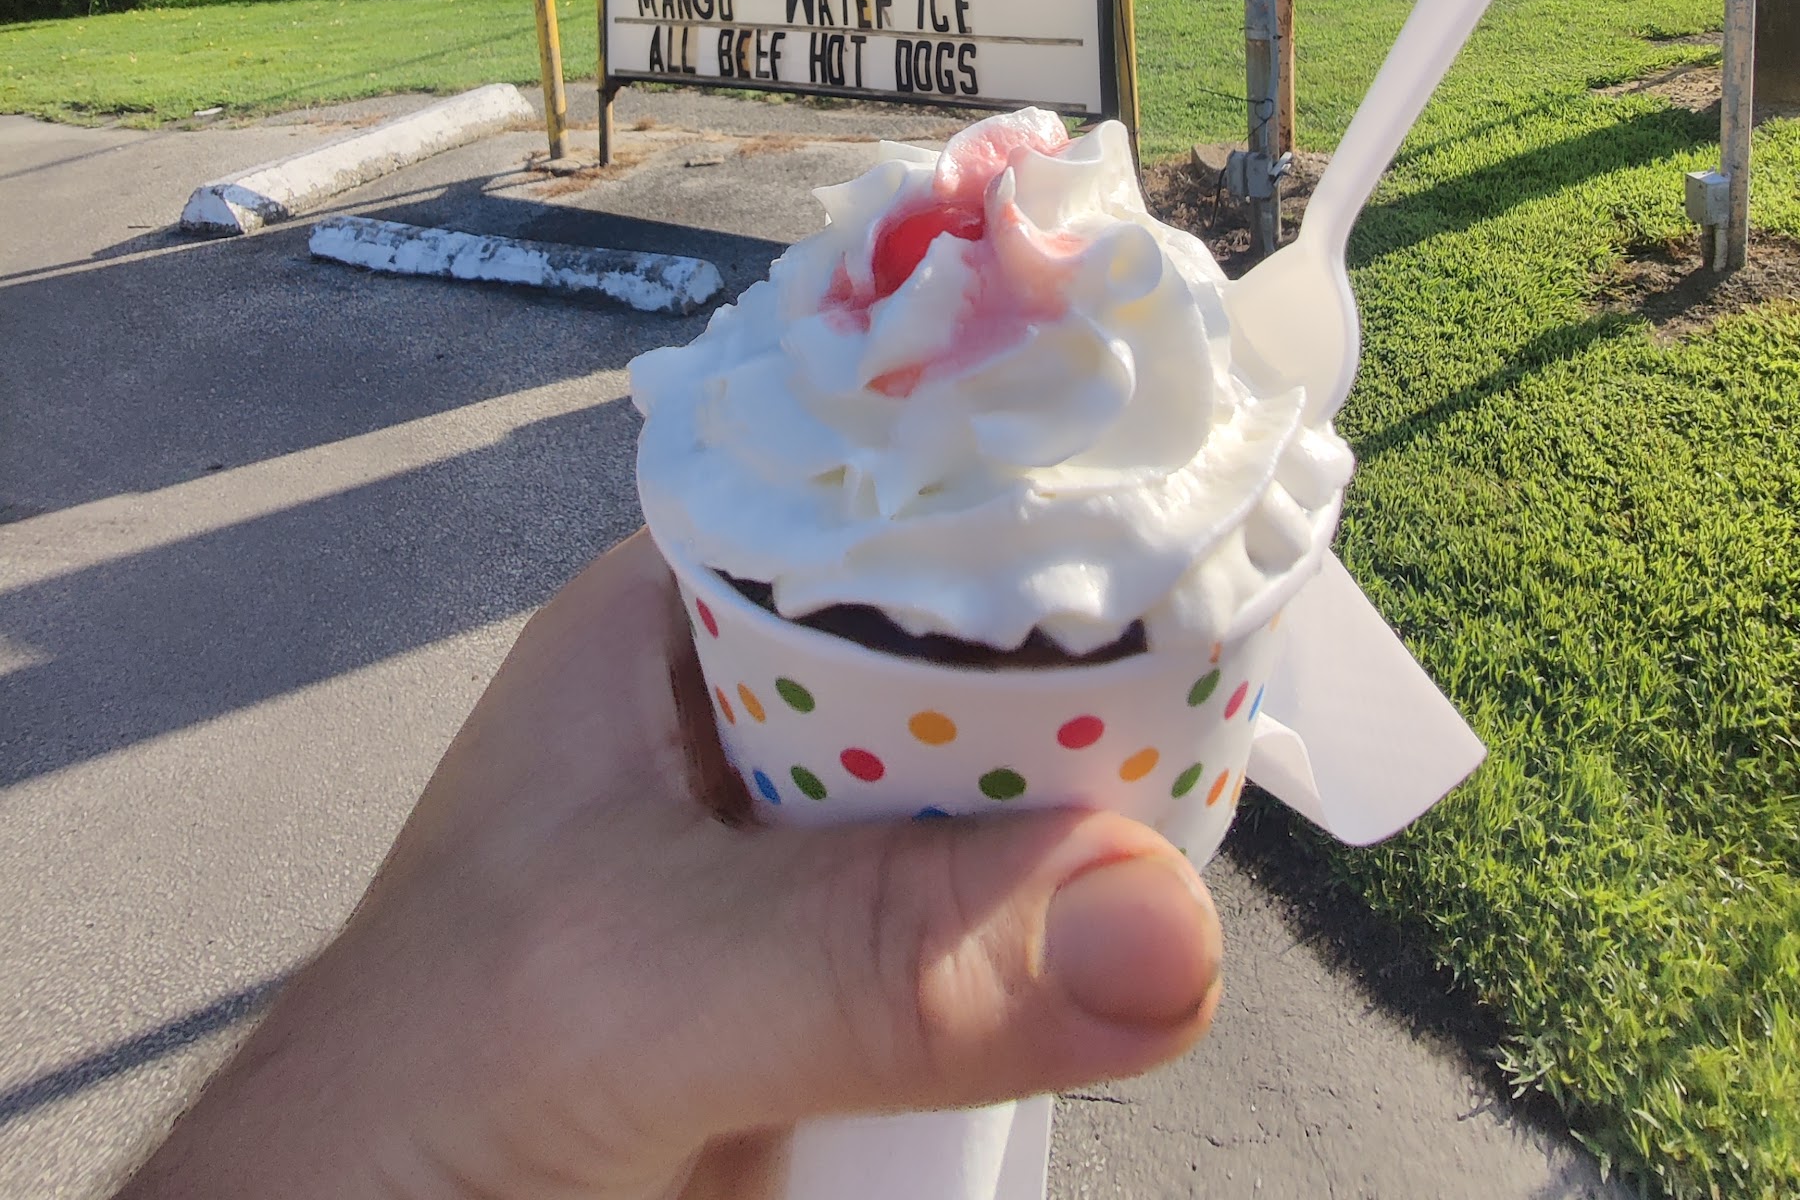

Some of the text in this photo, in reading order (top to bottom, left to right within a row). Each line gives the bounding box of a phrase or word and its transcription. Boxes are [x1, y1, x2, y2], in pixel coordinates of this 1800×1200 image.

[650, 25, 979, 95] ALL BEEF HOT DOGS
